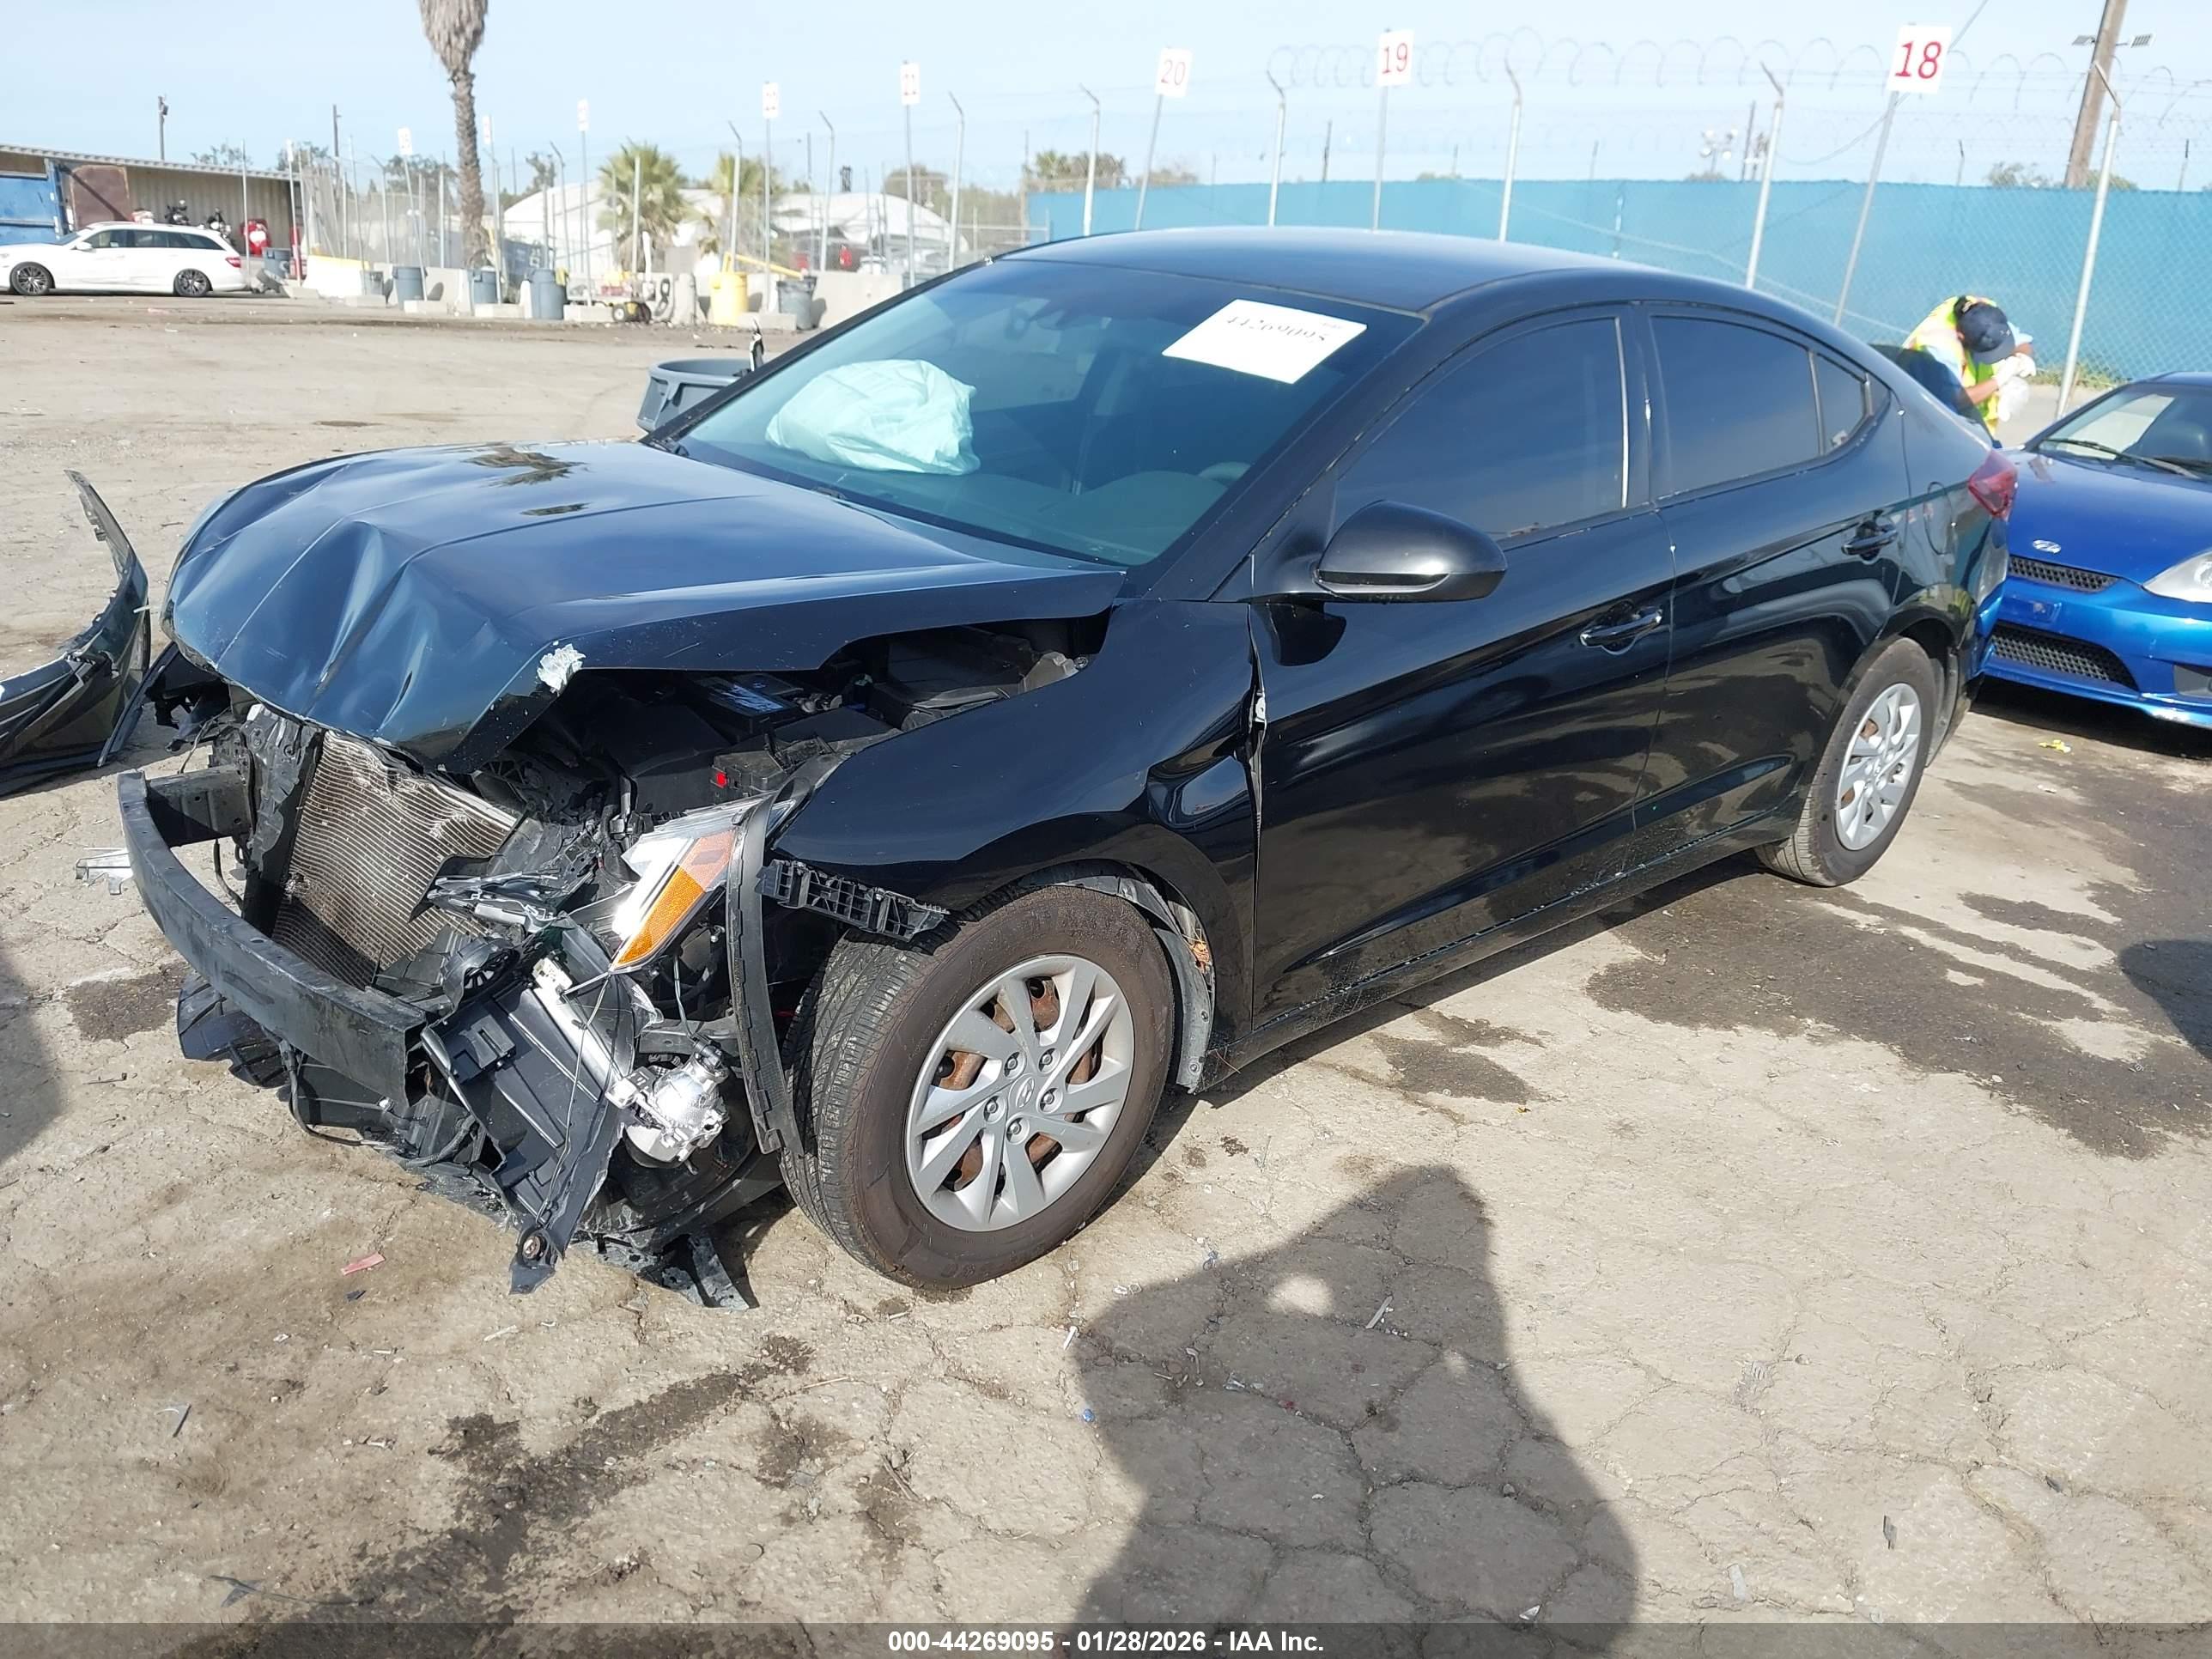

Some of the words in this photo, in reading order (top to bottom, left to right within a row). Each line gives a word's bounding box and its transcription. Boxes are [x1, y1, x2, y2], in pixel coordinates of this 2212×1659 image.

[1160, 58, 1186, 86] 20
[1382, 42, 1408, 75] 19
[1894, 40, 1942, 79] 18
